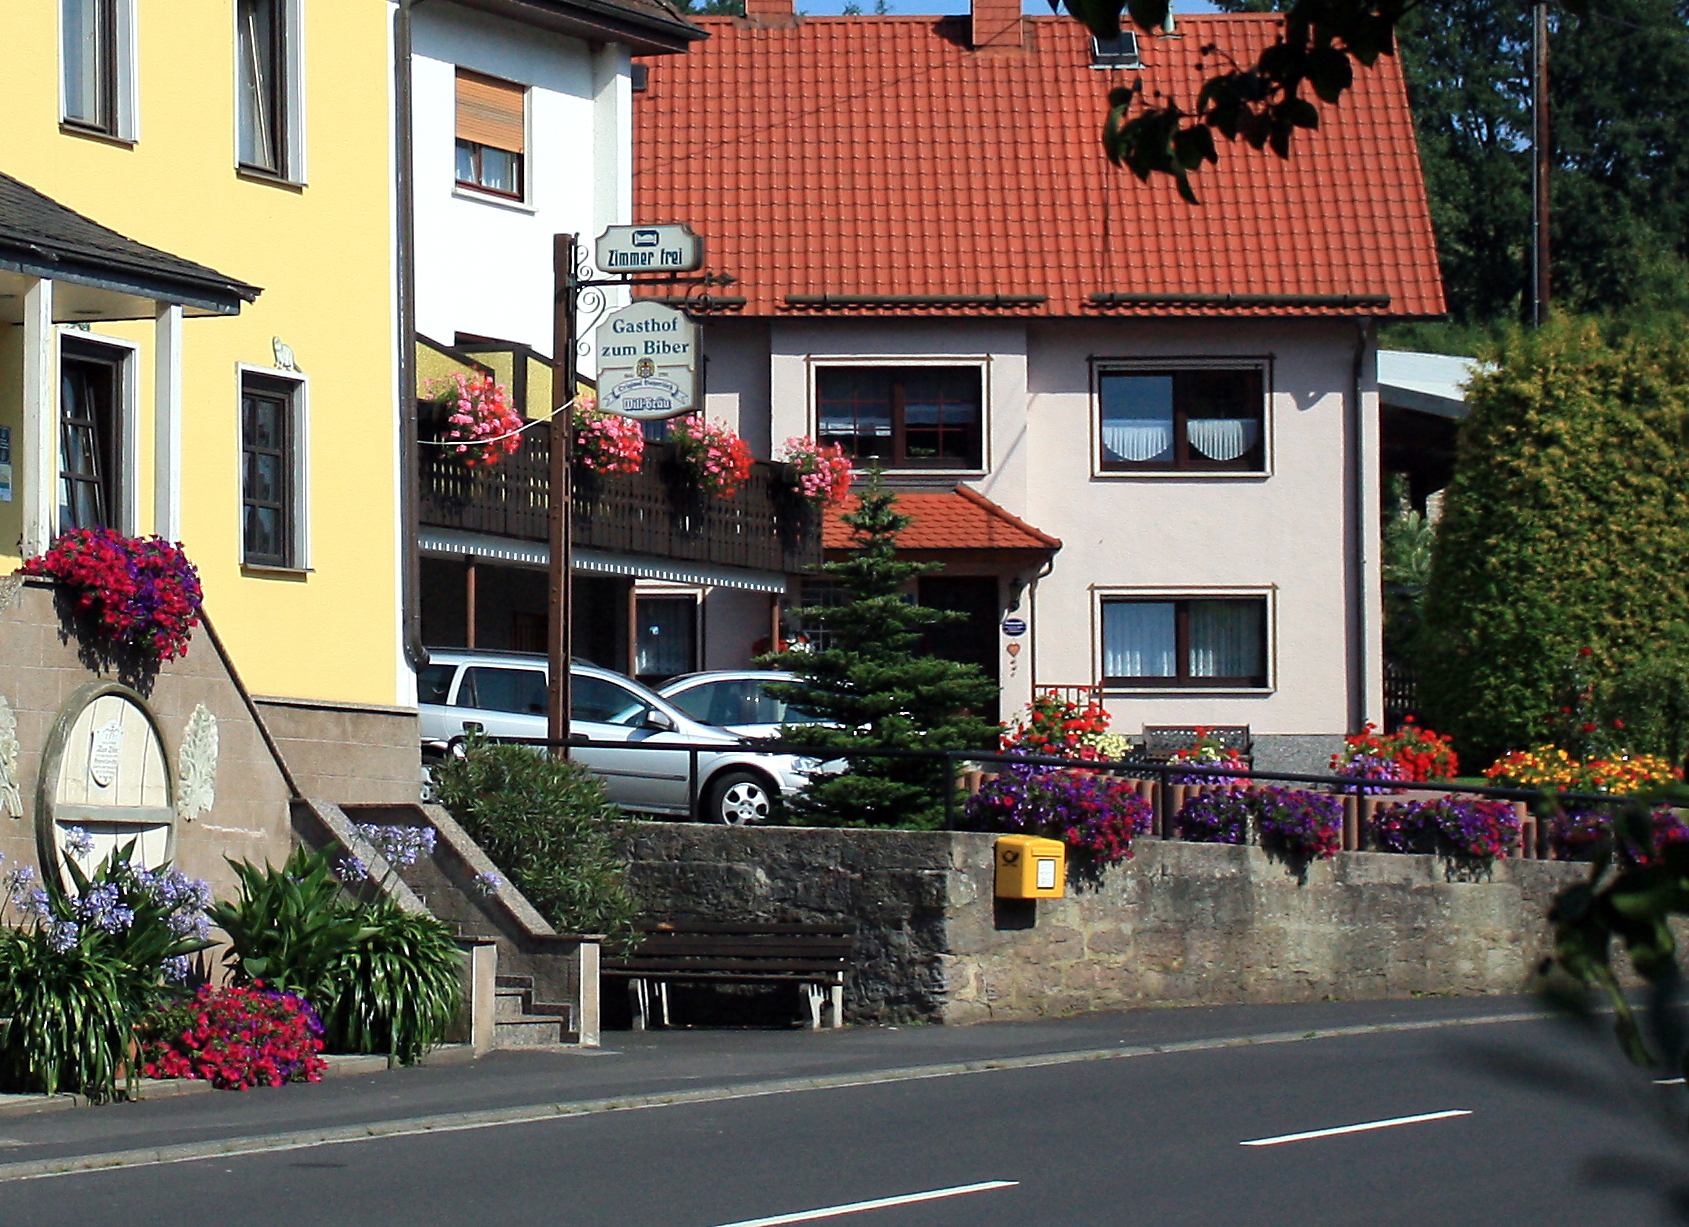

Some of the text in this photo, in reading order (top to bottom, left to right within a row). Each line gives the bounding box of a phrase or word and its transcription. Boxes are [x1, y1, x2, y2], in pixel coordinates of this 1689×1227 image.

[608, 247, 683, 267] Zimmer frei
[612, 317, 678, 334] Gasthof
[601, 340, 690, 357] zum Biber
